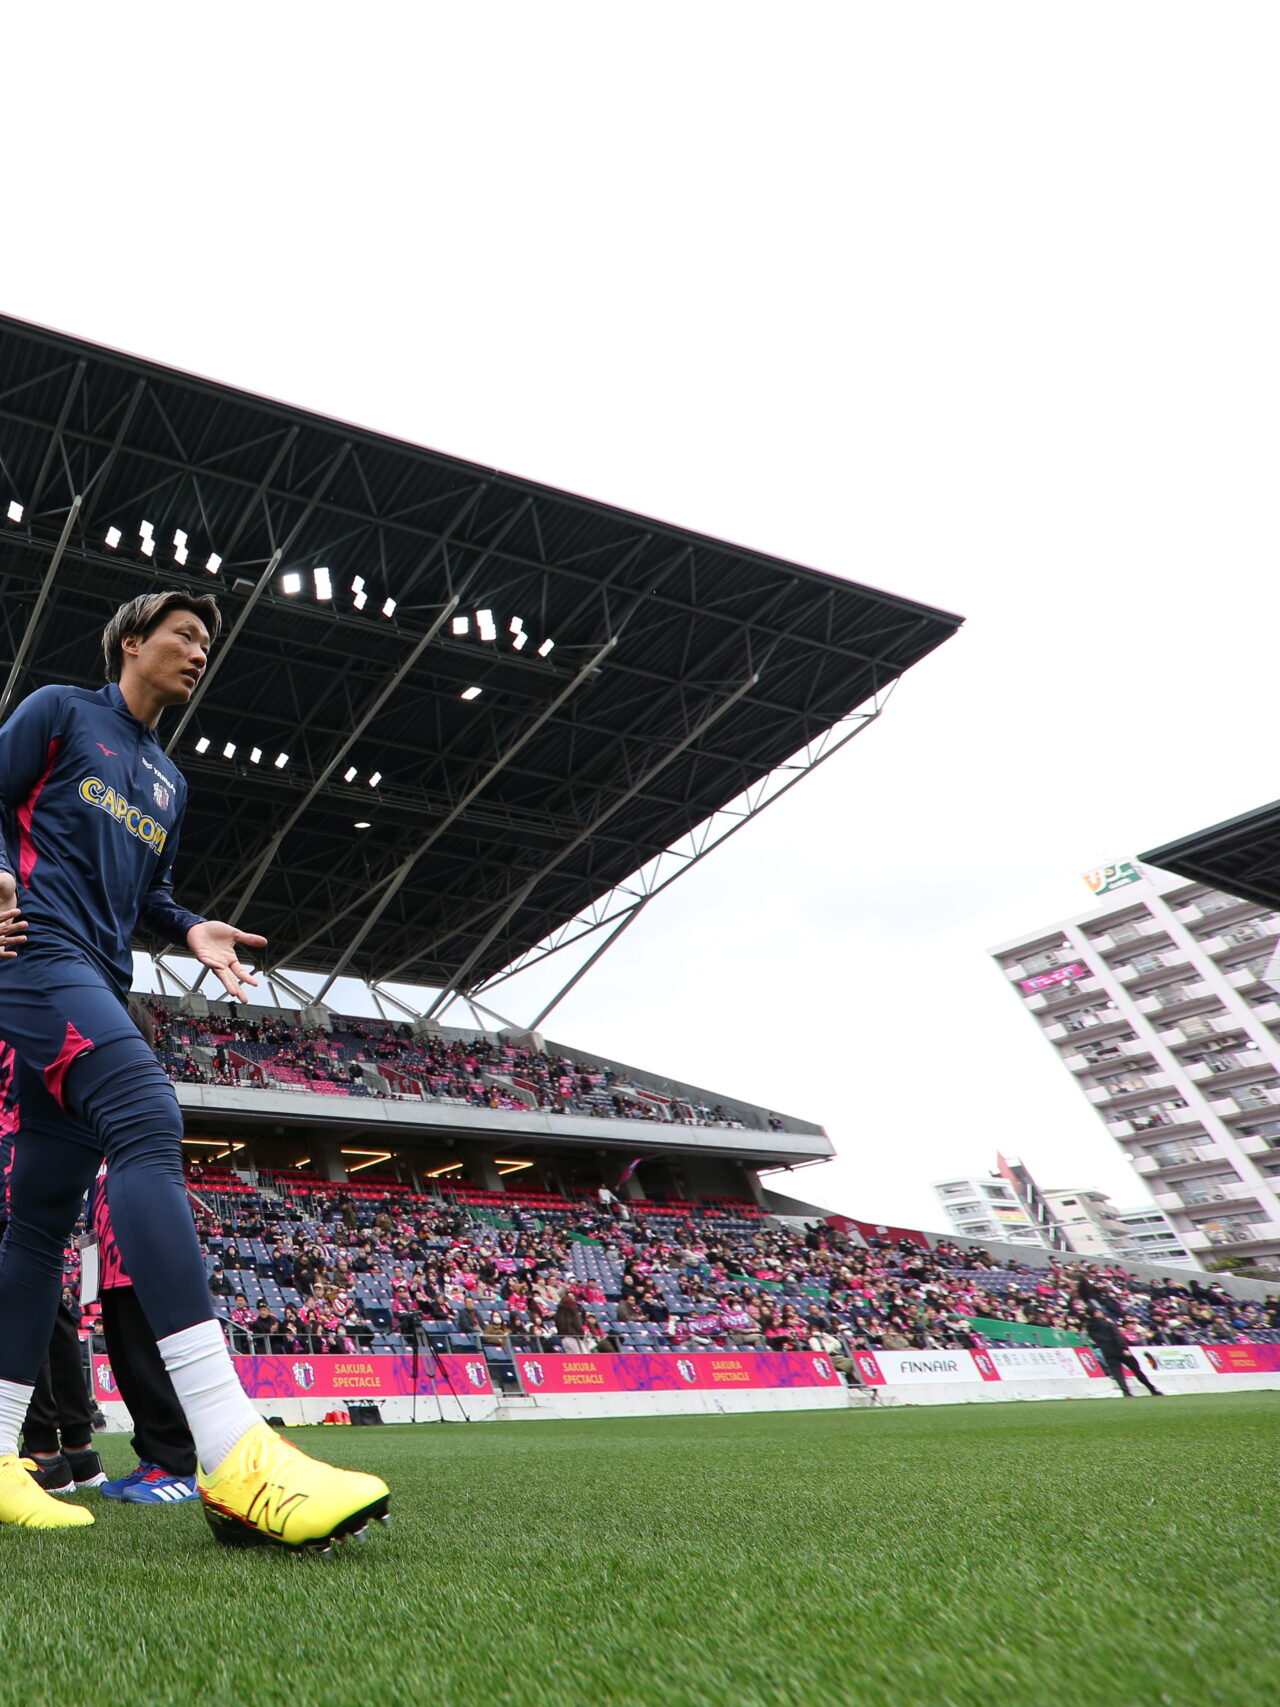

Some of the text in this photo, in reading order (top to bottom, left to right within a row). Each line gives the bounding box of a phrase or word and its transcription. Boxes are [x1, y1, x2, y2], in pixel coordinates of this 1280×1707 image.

[79, 776, 168, 856] CAPCOM
[335, 1363, 374, 1374] SAKURA
[563, 1362, 597, 1372] SAKURA
[712, 1360, 742, 1370] SAKURA
[900, 1360, 958, 1373] FINNAIR
[563, 1374, 604, 1384] SPECTACLE
[712, 1371, 749, 1381] SPECTACLE
[332, 1377, 381, 1388] SPECTACLE
